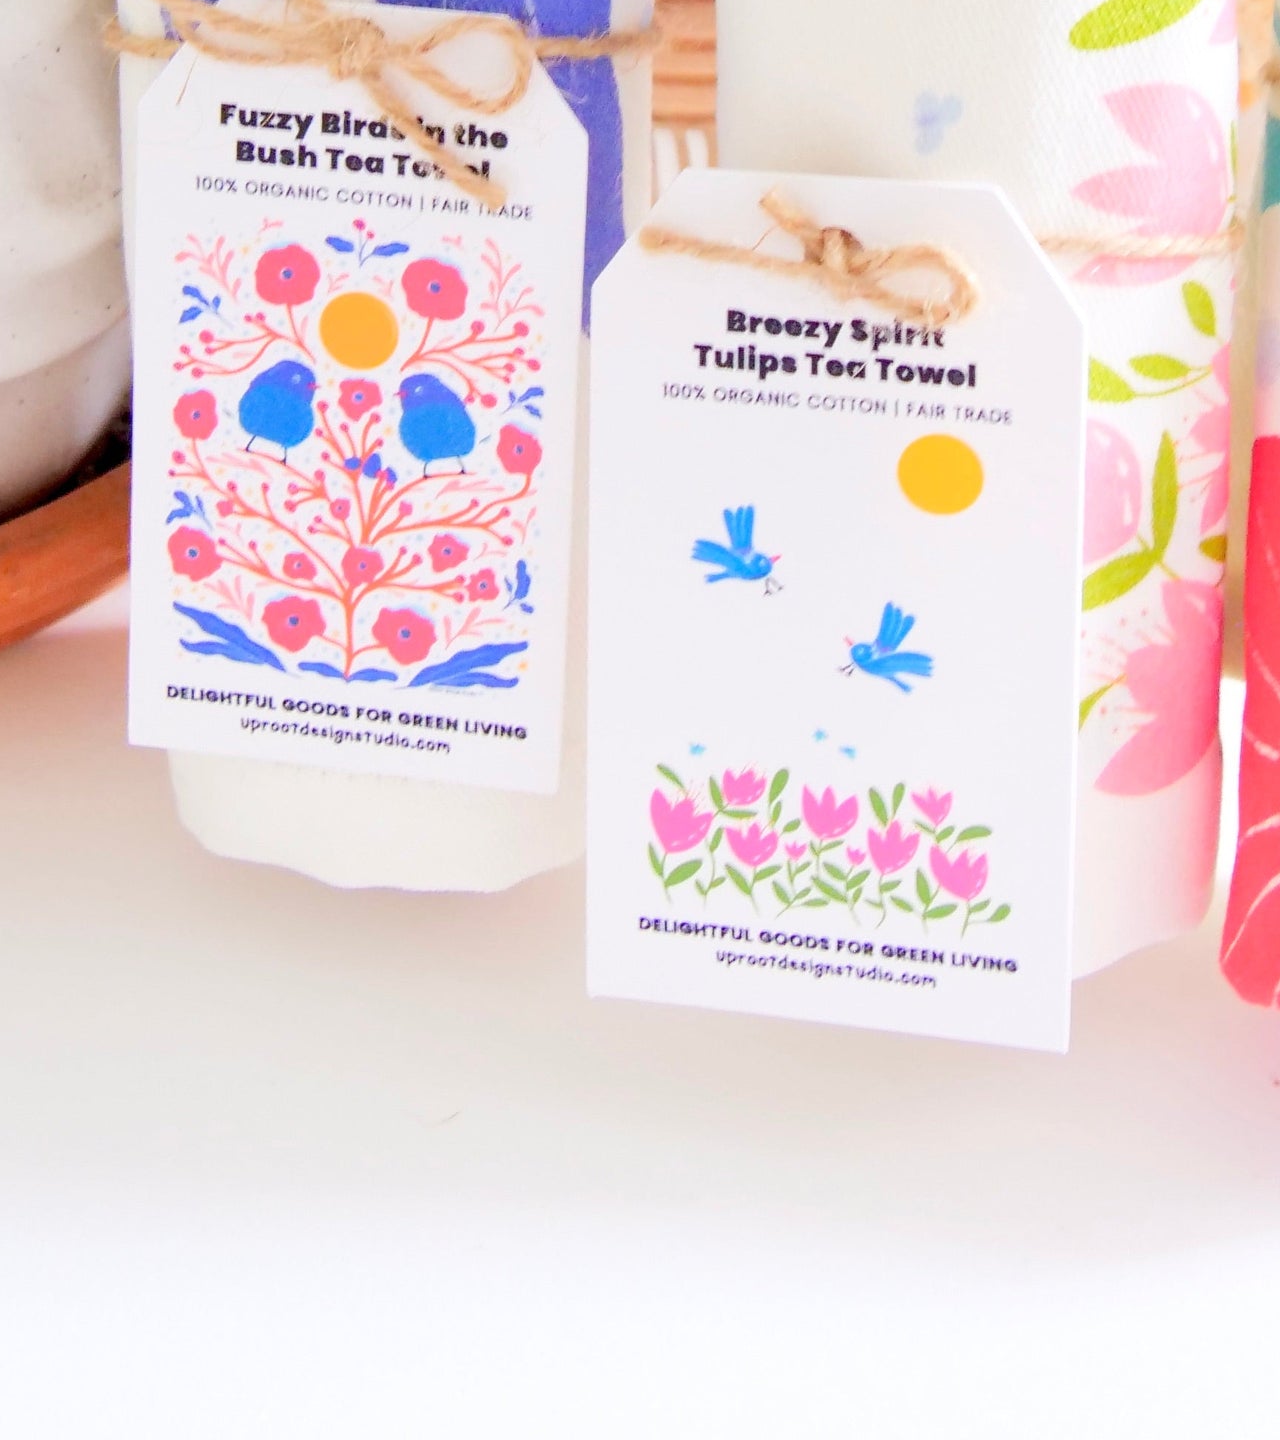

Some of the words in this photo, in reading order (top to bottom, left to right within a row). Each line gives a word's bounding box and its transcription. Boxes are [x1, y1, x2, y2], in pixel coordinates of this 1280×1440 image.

[220, 103, 314, 140] Fuzzy
[455, 123, 509, 149] the
[236, 140, 318, 168] Bush
[326, 148, 384, 174] Tea
[196, 175, 237, 193] 100%
[245, 180, 329, 202] ORGANIC
[336, 187, 413, 209] COTTON
[432, 196, 469, 213] FAIR
[726, 309, 843, 348] Breezy
[851, 317, 946, 351] Spirit
[694, 343, 797, 380] Tulips
[805, 352, 867, 379] Tea
[875, 357, 977, 388] Towel
[662, 382, 706, 400] 100%
[713, 386, 800, 408] ORGANIC
[807, 393, 887, 415] COTTON
[906, 401, 946, 419] FAIR
[954, 406, 1013, 425] TRADE
[167, 685, 276, 710] DELIGHTFUL
[281, 698, 350, 719] GOODS
[355, 707, 393, 724] FOR
[398, 711, 459, 732] GREEN
[464, 721, 529, 740] LIVING
[239, 716, 451, 755] uprootdesignstudio.com
[639, 916, 753, 942] DELIGHTFUL
[758, 930, 830, 951] GOODS
[836, 939, 874, 956] FOR
[880, 944, 944, 966] GREEN
[951, 953, 1018, 974] LIVING
